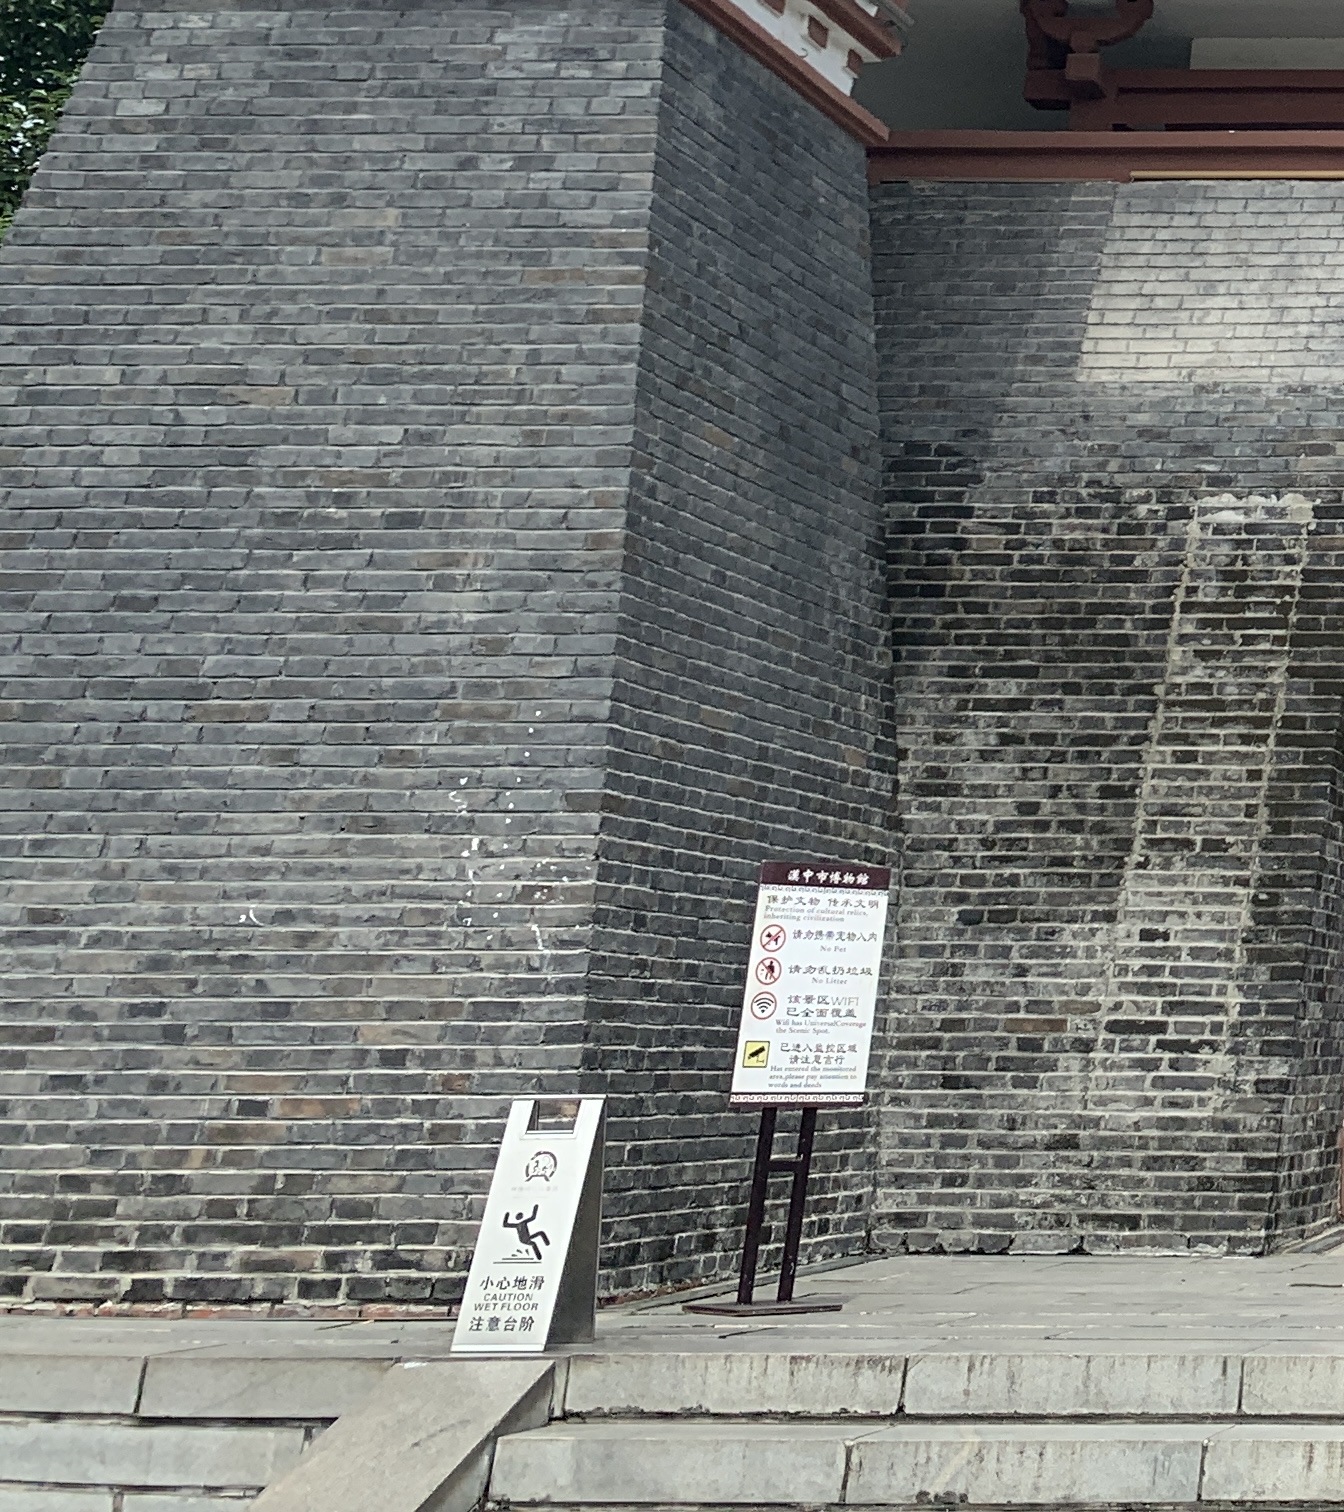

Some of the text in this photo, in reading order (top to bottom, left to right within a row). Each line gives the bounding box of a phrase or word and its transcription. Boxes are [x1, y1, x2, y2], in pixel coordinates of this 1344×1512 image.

[767, 895, 879, 909] 保护文物 传承文明
[765, 905, 804, 913] Protection
[816, 907, 844, 915] cultural
[793, 929, 878, 942] 请勿携带宠物入内
[788, 965, 873, 976] 请勿乱扔垃圾
[786, 1007, 857, 1018] 已全面覆盖
[780, 1043, 857, 1053] 已进入监控区域
[480, 1276, 545, 1290] 小心地滑
[483, 1293, 534, 1301] CAUTION
[474, 1303, 539, 1311] WET FLOOR
[469, 1316, 534, 1331] 注意台阶
